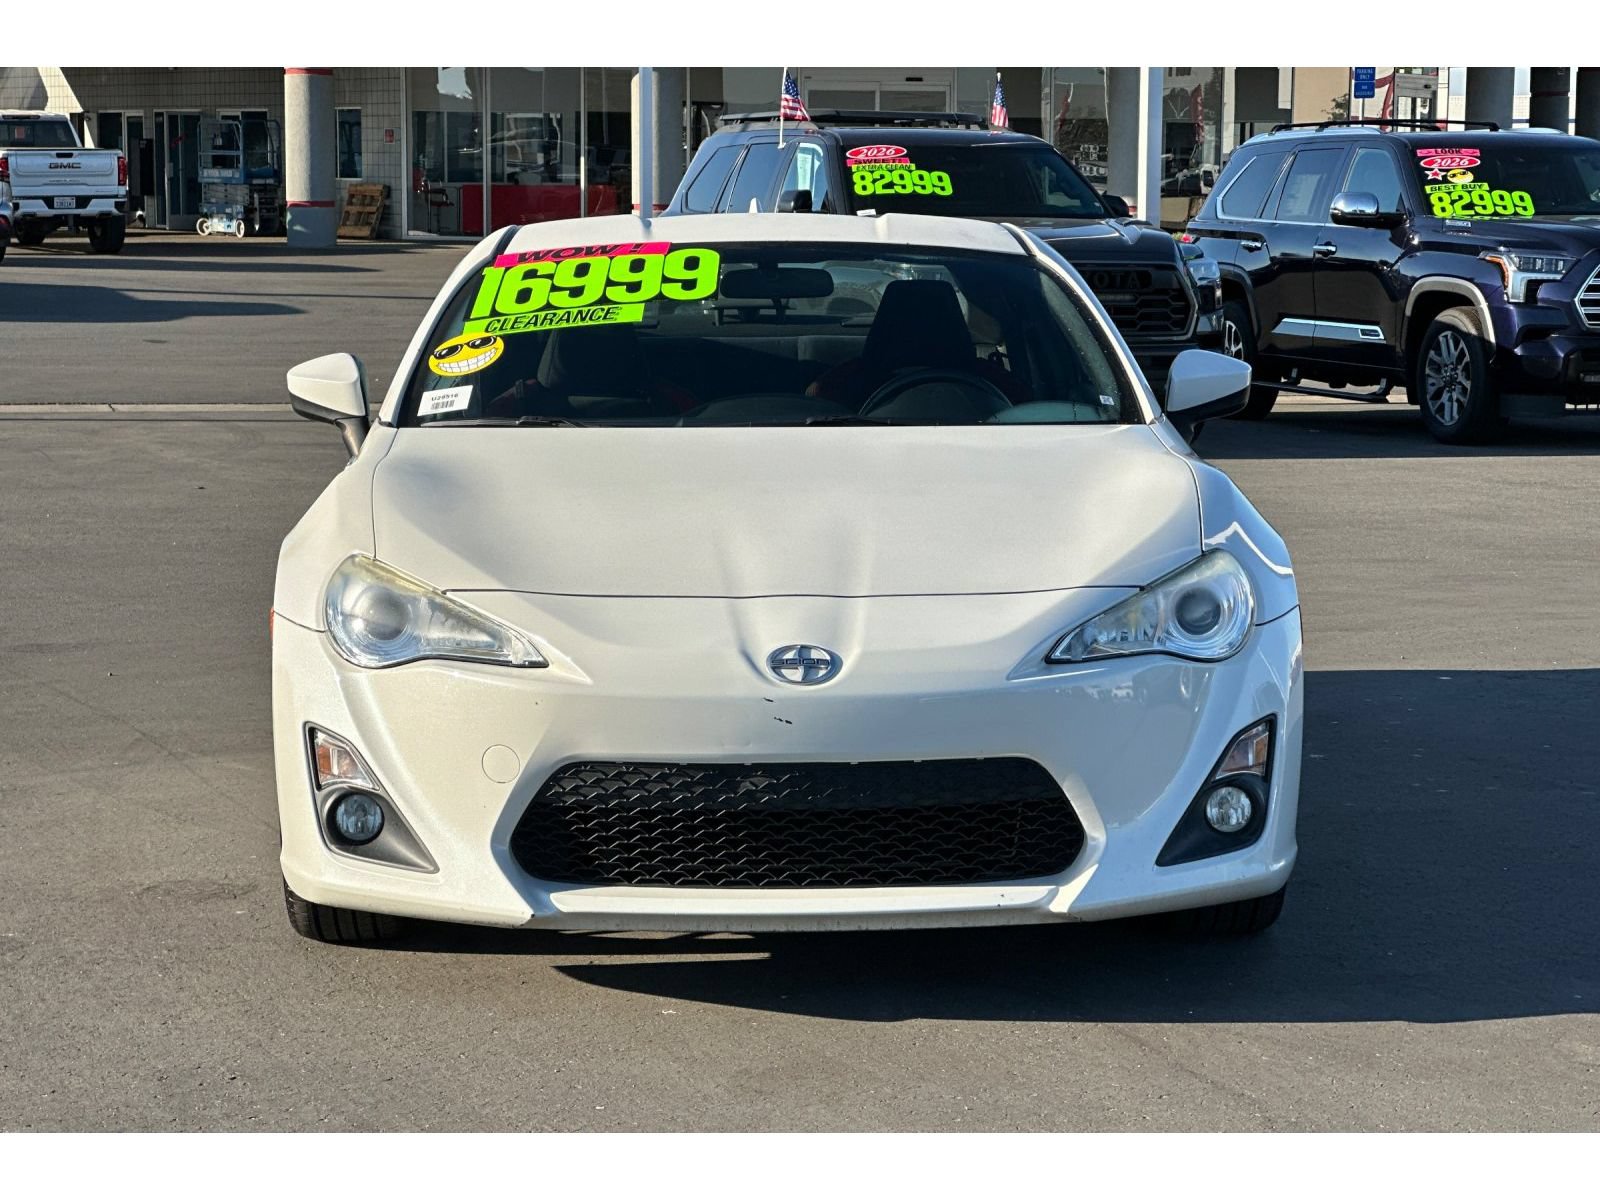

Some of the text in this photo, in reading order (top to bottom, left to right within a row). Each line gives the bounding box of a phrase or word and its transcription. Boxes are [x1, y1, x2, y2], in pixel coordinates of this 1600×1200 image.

[858, 147, 896, 157] 2026
[1432, 157, 1469, 167] 2026
[852, 169, 953, 195] 82999
[1430, 189, 1535, 218] 82999
[470, 248, 720, 319] 16999
[484, 306, 622, 335] CLEARANCE
